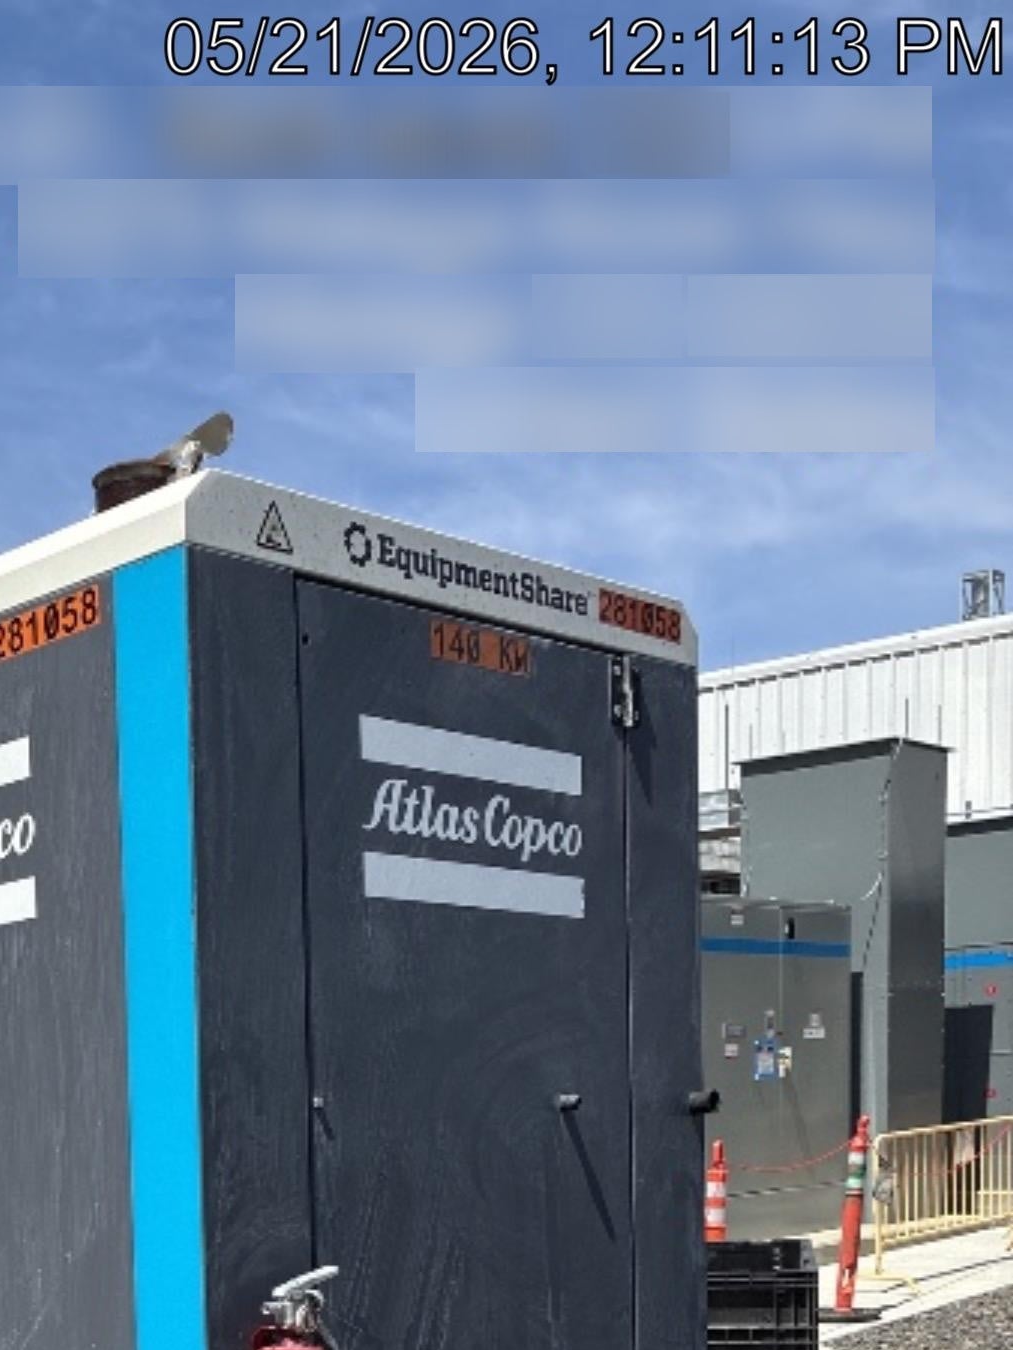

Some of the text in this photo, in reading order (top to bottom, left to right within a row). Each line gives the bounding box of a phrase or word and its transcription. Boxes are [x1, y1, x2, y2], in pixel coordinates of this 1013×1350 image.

[376, 532, 590, 617] EquipmentShare
[433, 627, 529, 673] 140 KW
[599, 589, 682, 643] 281058
[361, 778, 583, 862] Atlas Copco
